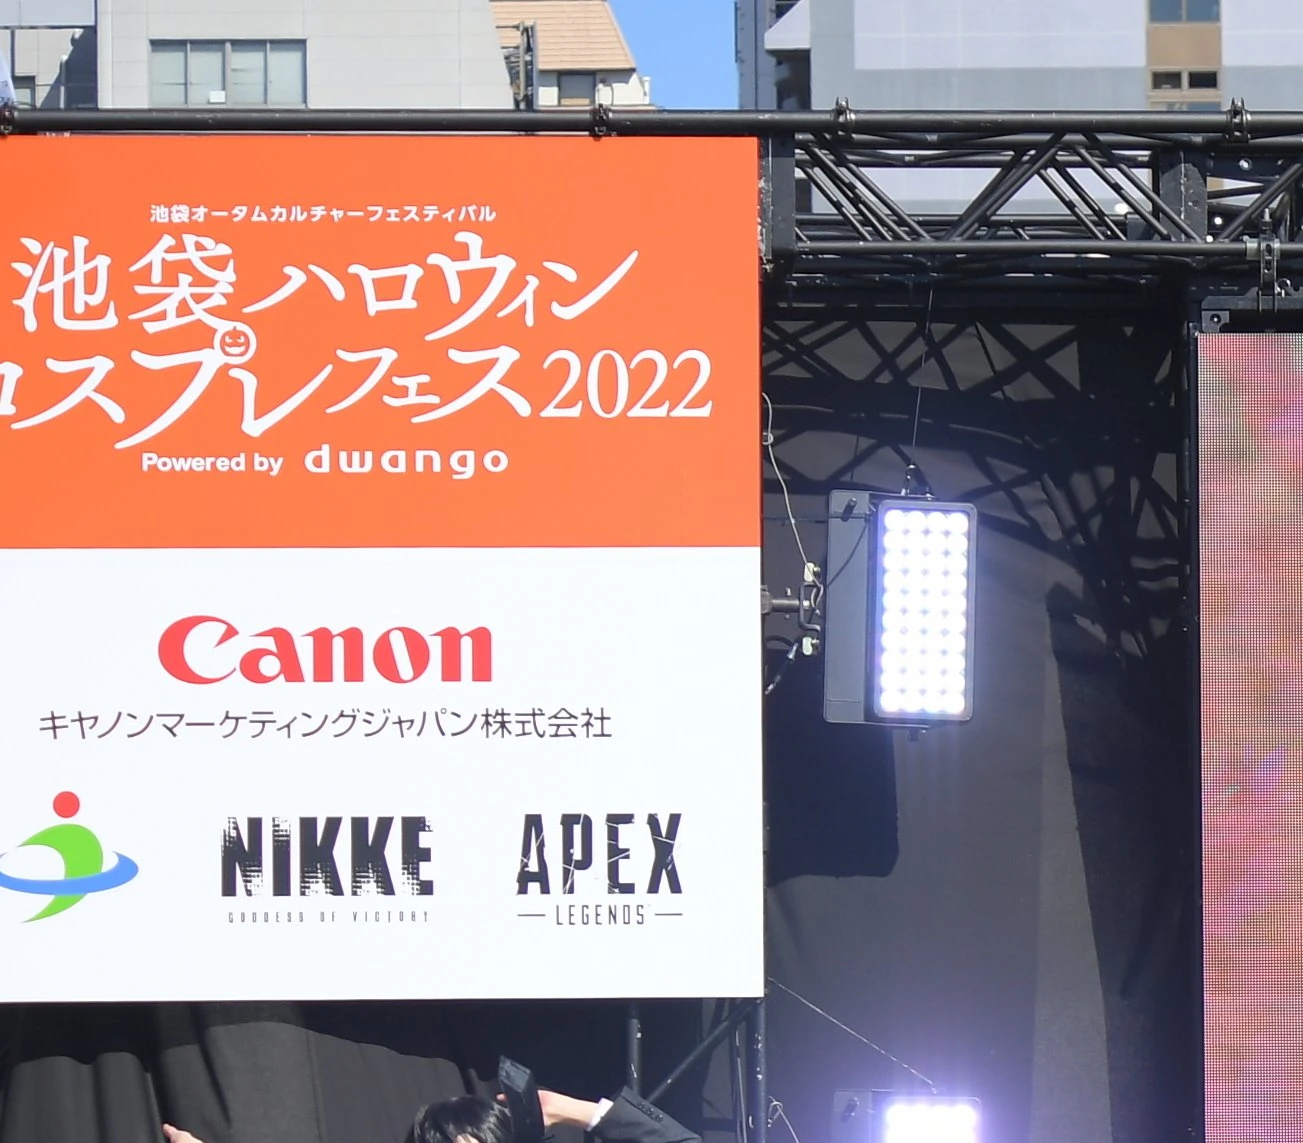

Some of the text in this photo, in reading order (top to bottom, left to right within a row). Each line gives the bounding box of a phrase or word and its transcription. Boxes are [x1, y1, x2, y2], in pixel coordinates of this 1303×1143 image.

[149, 203, 497, 224] 池袋オータムカルチャーフェスティバル
[11, 229, 640, 342] 池袋ハロウィン
[141, 443, 510, 481] Powered by dwango
[158, 615, 494, 685] Canon
[38, 706, 613, 741] キヤノンマーケティングジャパン株式会社
[221, 815, 434, 898] NIKKE
[515, 812, 683, 897] APEX
[228, 911, 428, 924] GODDESS OF VICTORY
[556, 904, 645, 926] LEGENDS
